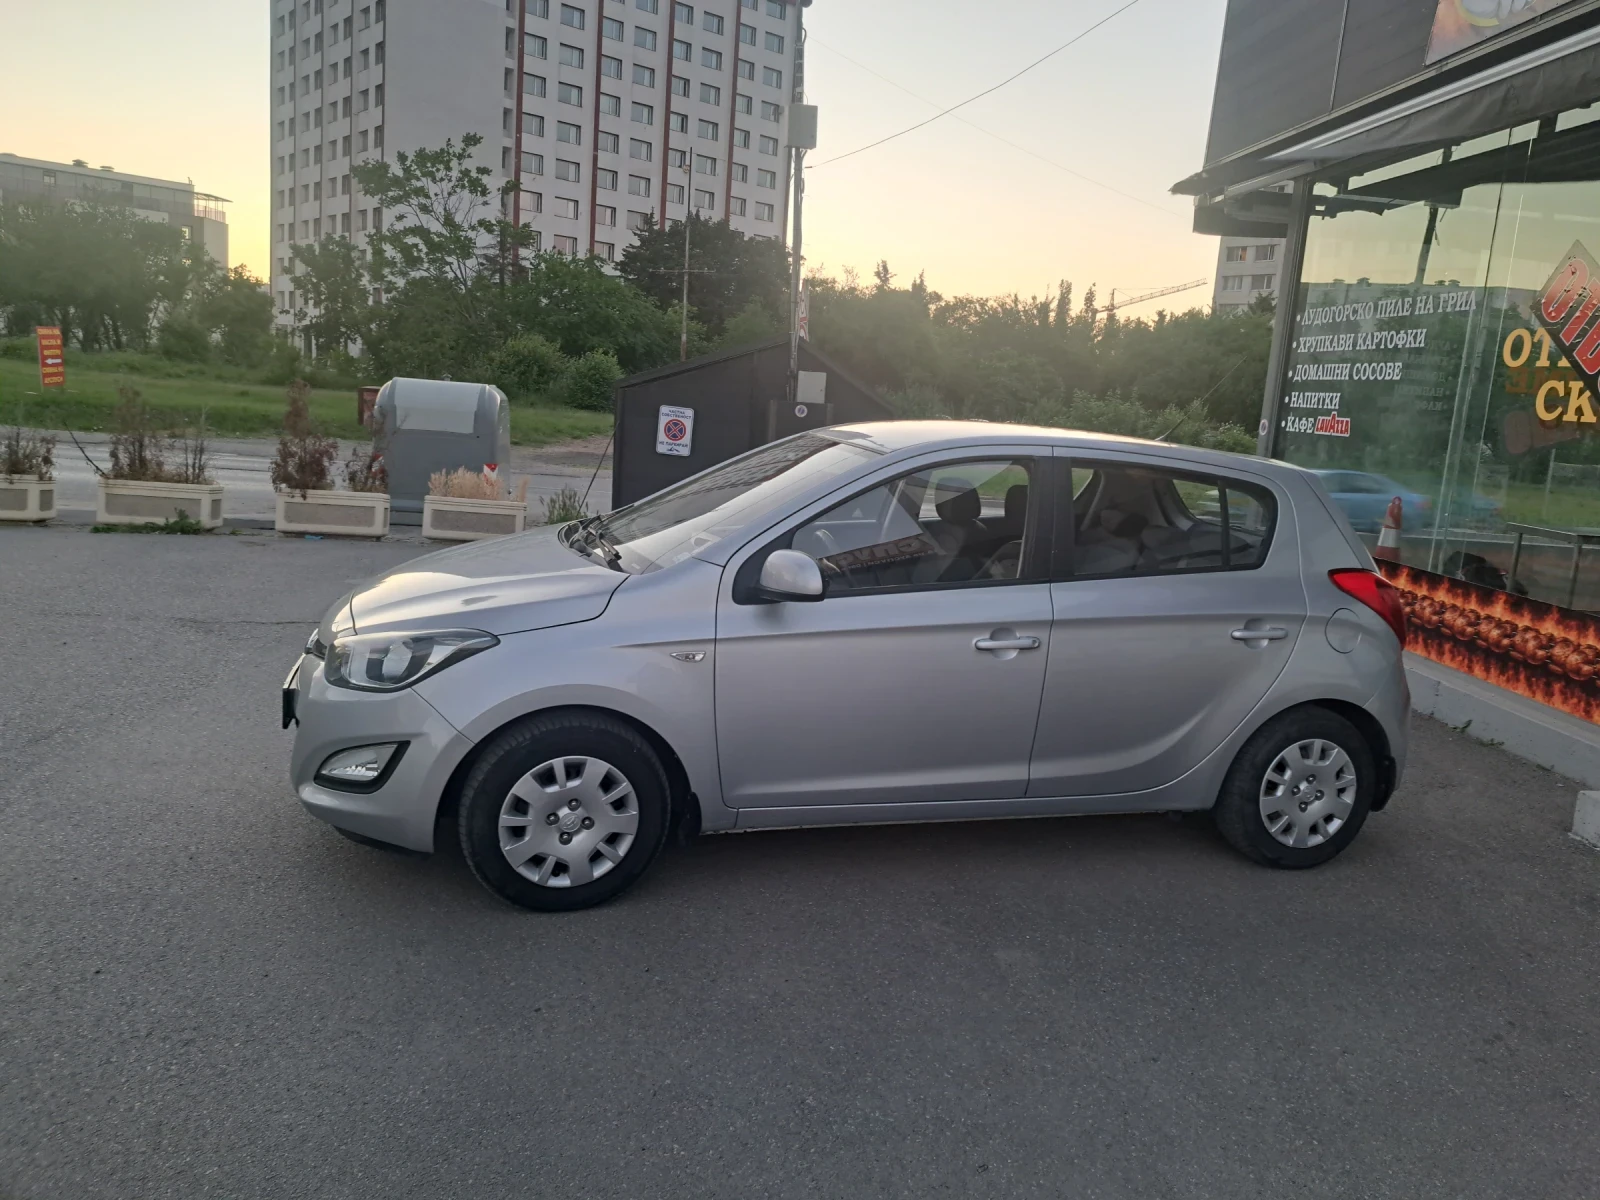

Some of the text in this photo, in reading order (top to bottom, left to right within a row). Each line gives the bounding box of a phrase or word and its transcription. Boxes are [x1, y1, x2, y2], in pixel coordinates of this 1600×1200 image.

[1301, 290, 1477, 326] ЛУДОГОРСКО ПИЛЕ НА ГРИЛ
[1297, 333, 1353, 353] ХРУПКАВИ
[1355, 328, 1427, 350] КАРТОФКИ
[1293, 363, 1351, 382] ДОМАШНИ
[1352, 361, 1403, 380] СОСОВЕ
[1289, 391, 1341, 409] НАПИТКИ
[1285, 412, 1350, 436] КАФЕ LAVAZZA
